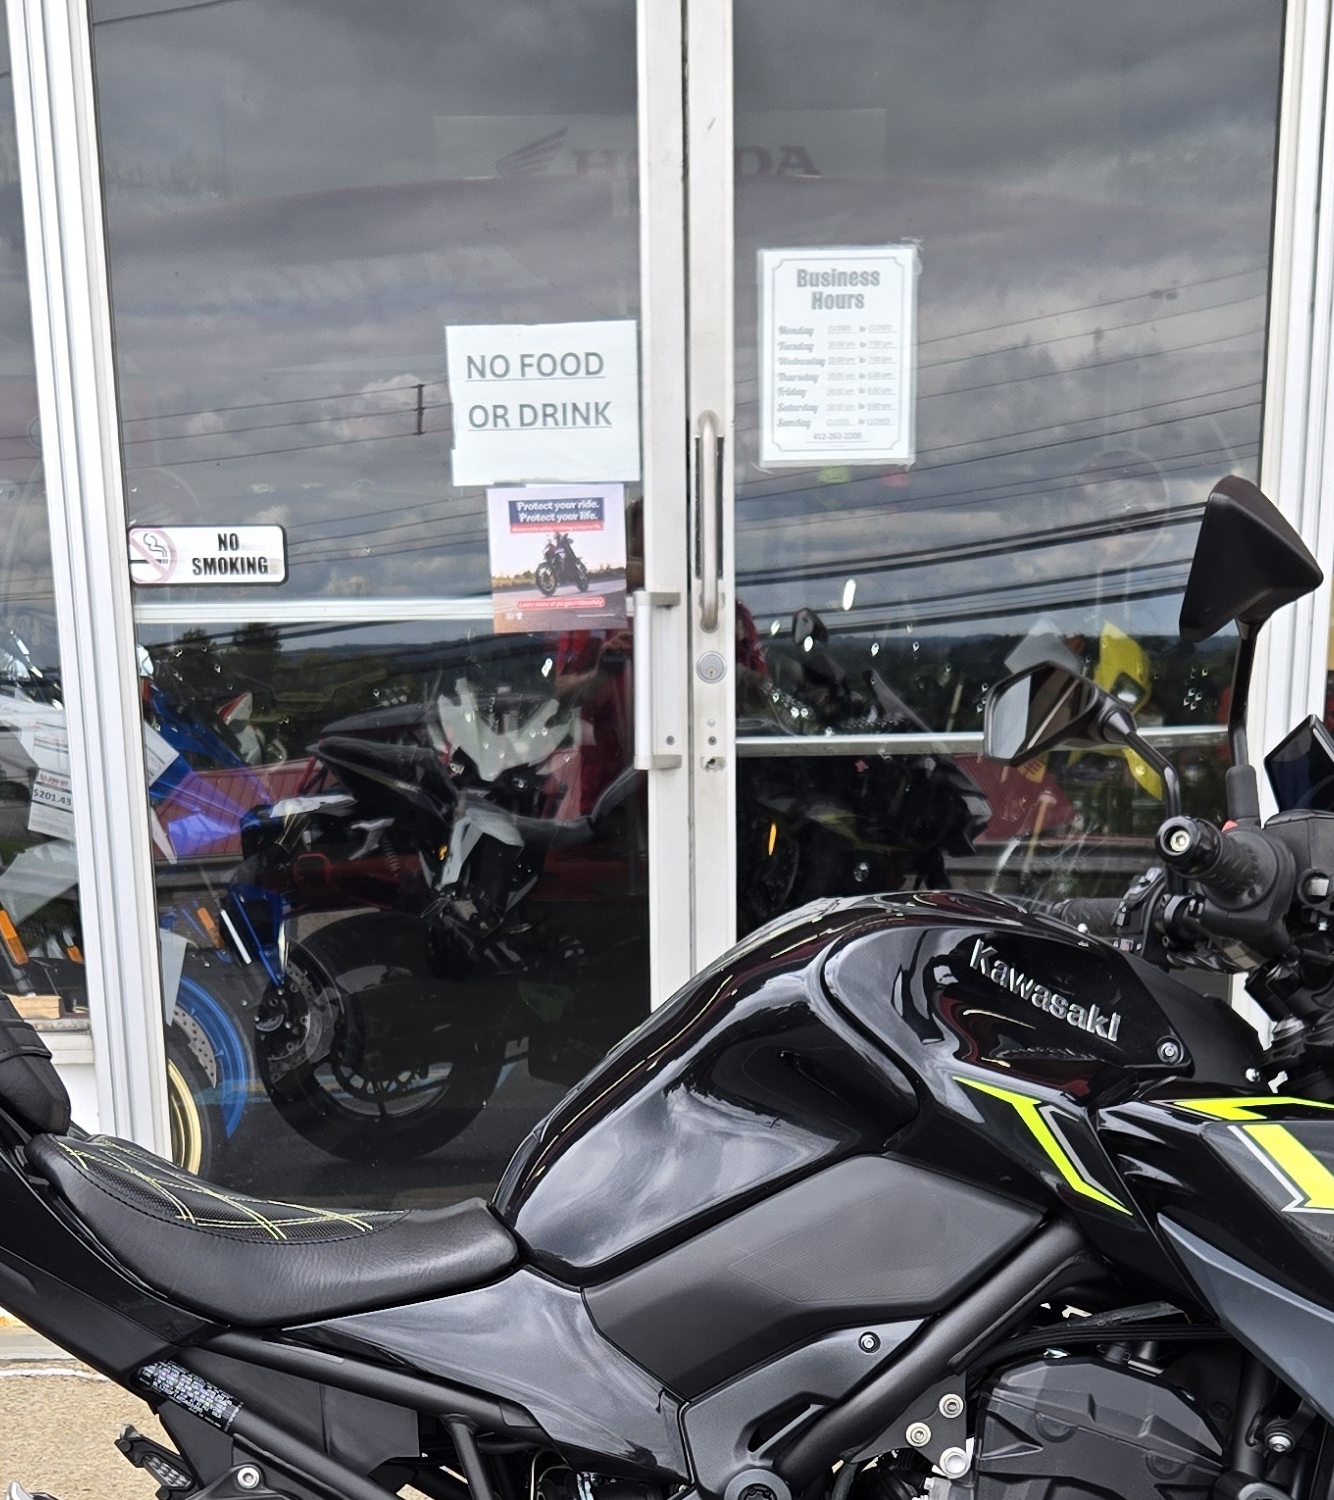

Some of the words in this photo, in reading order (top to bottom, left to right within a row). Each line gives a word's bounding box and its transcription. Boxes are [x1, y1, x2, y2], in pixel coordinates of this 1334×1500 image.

[796, 268, 881, 288] Business
[811, 291, 865, 310] Hours
[466, 354, 511, 379] NO
[519, 351, 605, 378] FOOD
[468, 404, 511, 429] OR
[518, 401, 613, 427] DRINK
[517, 501, 554, 512] Protect
[554, 500, 577, 512] your
[577, 499, 600, 509] ride.
[519, 512, 556, 523] Protect
[556, 512, 579, 524] your
[579, 510, 599, 521] life.
[217, 533, 240, 552] NO
[192, 557, 269, 576] SMOKING
[33, 787, 72, 807] $201.43
[969, 937, 1122, 1042] Kawasaki
